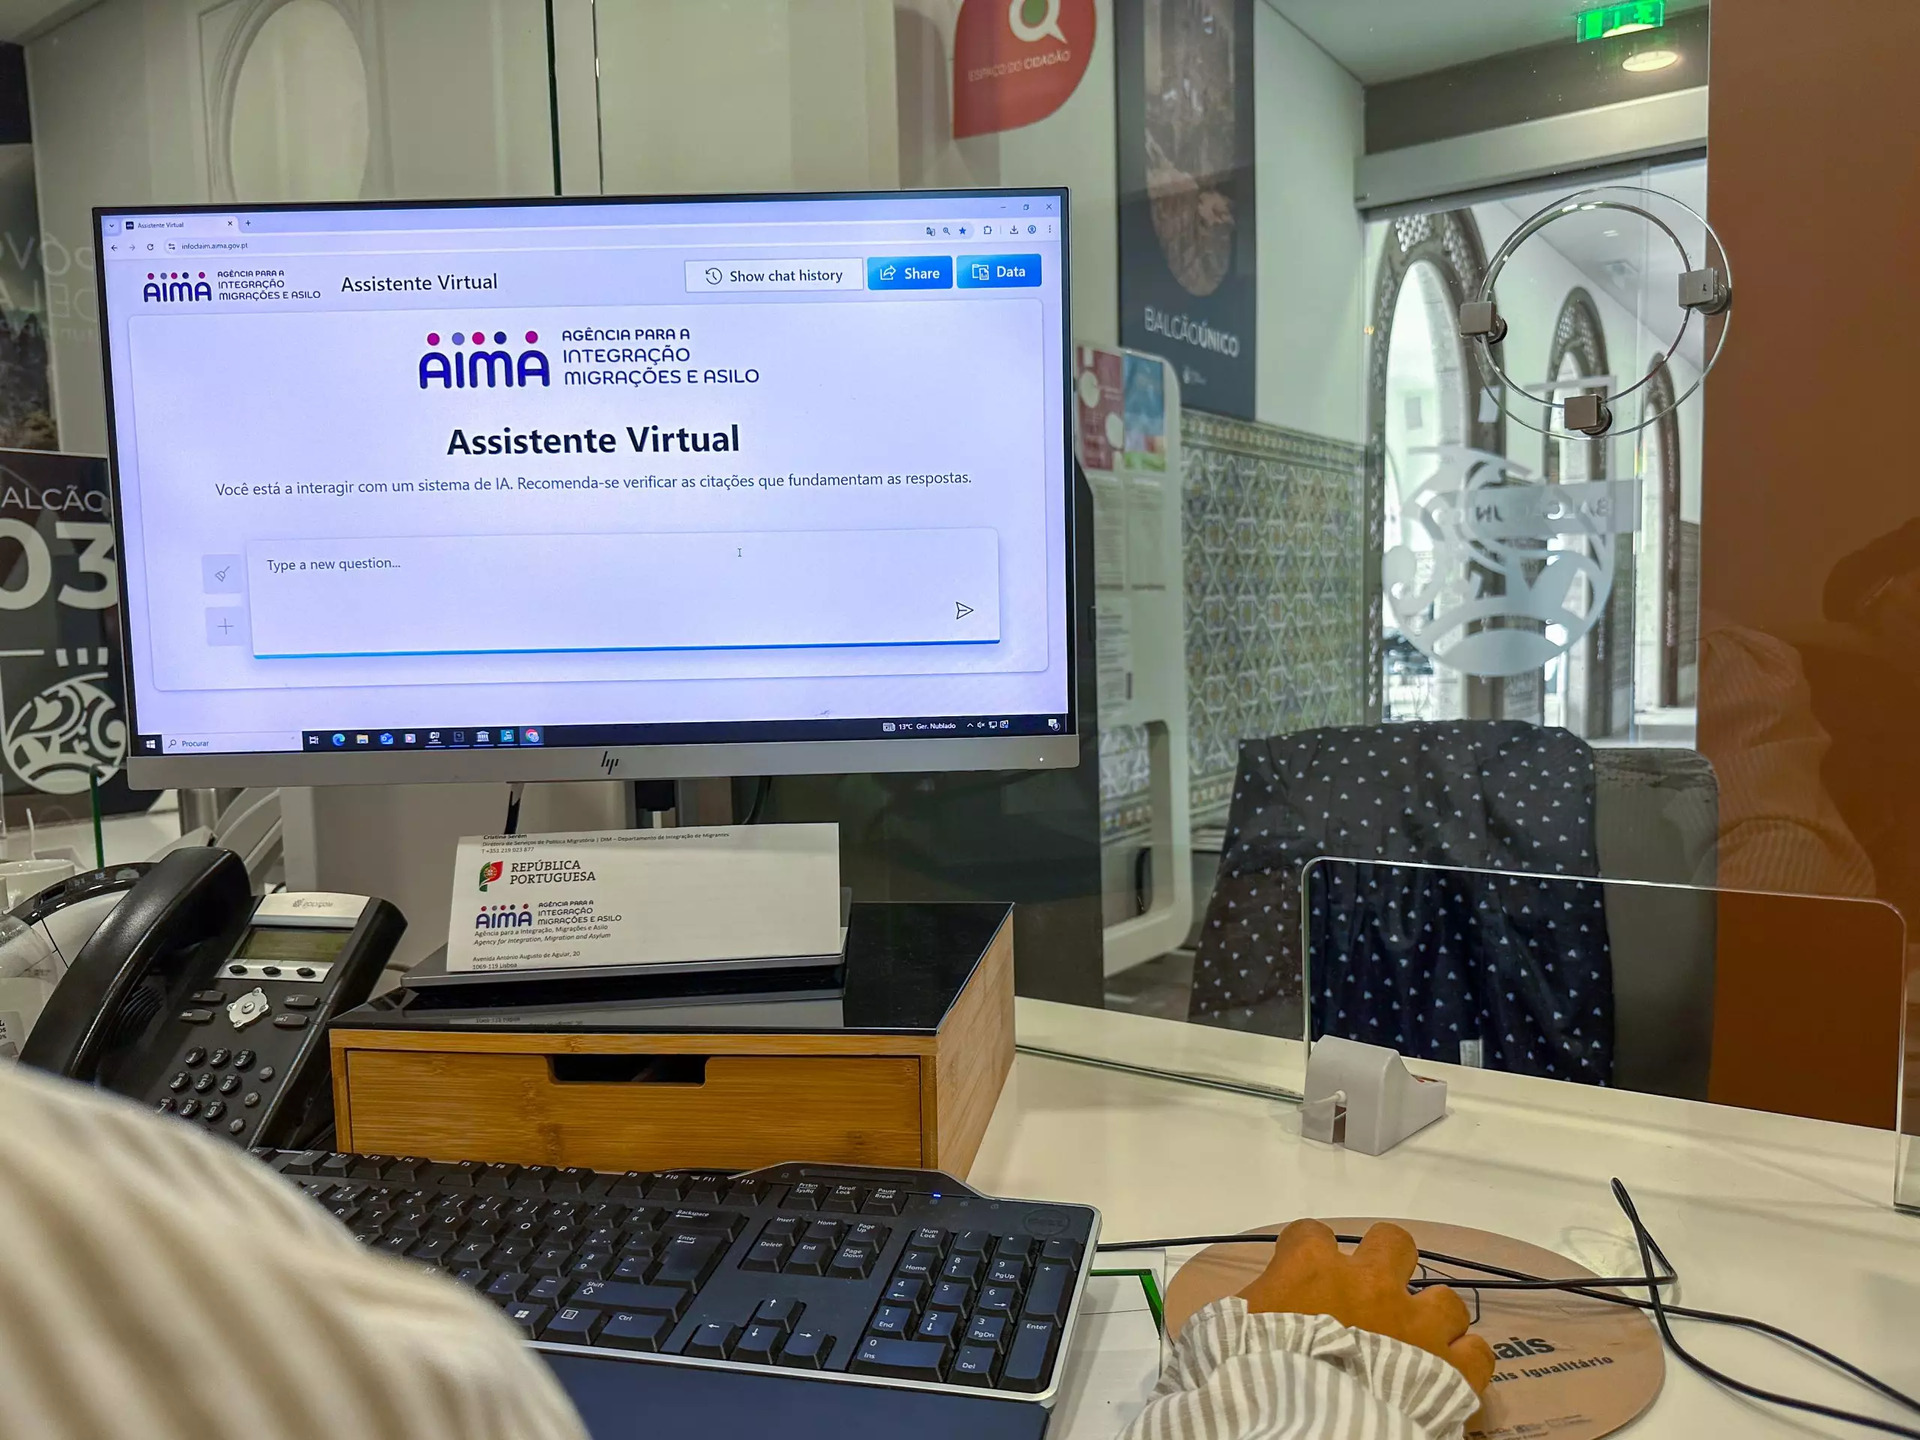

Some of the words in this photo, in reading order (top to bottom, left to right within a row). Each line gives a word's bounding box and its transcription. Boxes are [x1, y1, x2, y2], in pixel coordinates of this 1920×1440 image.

[217, 270, 254, 278] AGÊNCIA
[730, 269, 765, 284] Show
[768, 268, 795, 283] chat
[799, 267, 843, 285] history
[904, 266, 940, 281] Share
[996, 264, 1026, 278] Data
[218, 279, 285, 290] INTEGRAÇÃO
[341, 275, 433, 294] Assistente
[437, 273, 498, 291] Virtual
[143, 281, 212, 302] AIMA
[219, 290, 280, 301] MIGRAÇÕES
[291, 290, 321, 299] ASILO
[562, 328, 631, 341] AGÊNCIA
[635, 329, 675, 340] PARA
[680, 329, 690, 340] A
[563, 345, 690, 365] INTEGRAÇÃO
[419, 350, 550, 389] AIMA
[564, 367, 681, 387] MIGRAÇÕES
[687, 370, 698, 383] E
[703, 369, 760, 384] ASILO
[447, 427, 616, 455] Assistente
[626, 424, 740, 453] Virtual
[215, 482, 249, 496] Você
[253, 482, 281, 495] está
[285, 486, 293, 494] a
[297, 481, 354, 497] interagir
[358, 483, 388, 494] com
[392, 482, 414, 493] um
[418, 479, 470, 492] sistema
[474, 477, 492, 491] de
[495, 478, 514, 491] IA.
[517, 476, 620, 490] Recomenda-se
[623, 474, 676, 489] verificar
[681, 477, 696, 488] as
[699, 474, 755, 490] citações
[758, 476, 784, 491] que
[788, 472, 883, 488] fundamentam
[886, 475, 902, 485] as
[905, 472, 972, 488] respostas.
[0, 517, 119, 610] 03
[267, 559, 296, 573] Type
[299, 562, 307, 570] a
[310, 560, 335, 570] new
[338, 557, 401, 573] question...
[930, 722, 957, 730] Nublado
[181, 739, 210, 748] Procurar
[601, 751, 619, 775] hp
[511, 859, 581, 873] REPÚBLICA
[510, 871, 596, 885] PORTUGUESA
[538, 907, 594, 916] INTEGRAÇÃO
[475, 911, 533, 929] AIMA
[537, 916, 588, 925] MIGRAÇÕES
[597, 914, 622, 922] ASILO
[555, 925, 587, 933] Migrações
[473, 939, 496, 947] Agency
[496, 938, 507, 946] for
[676, 1209, 710, 1217] Backspace
[995, 1272, 1015, 1280] PgUp
[897, 1280, 905, 1288] 4
[930, 1313, 938, 1321] 2
[879, 1321, 894, 1329] End
[974, 1330, 995, 1338] PgDn
[869, 1339, 878, 1347] 0
[1493, 1337, 1555, 1360] ais
[962, 1362, 976, 1370] Del
[1490, 1372, 1519, 1383] ais
[1520, 1356, 1614, 1378] igualitário
